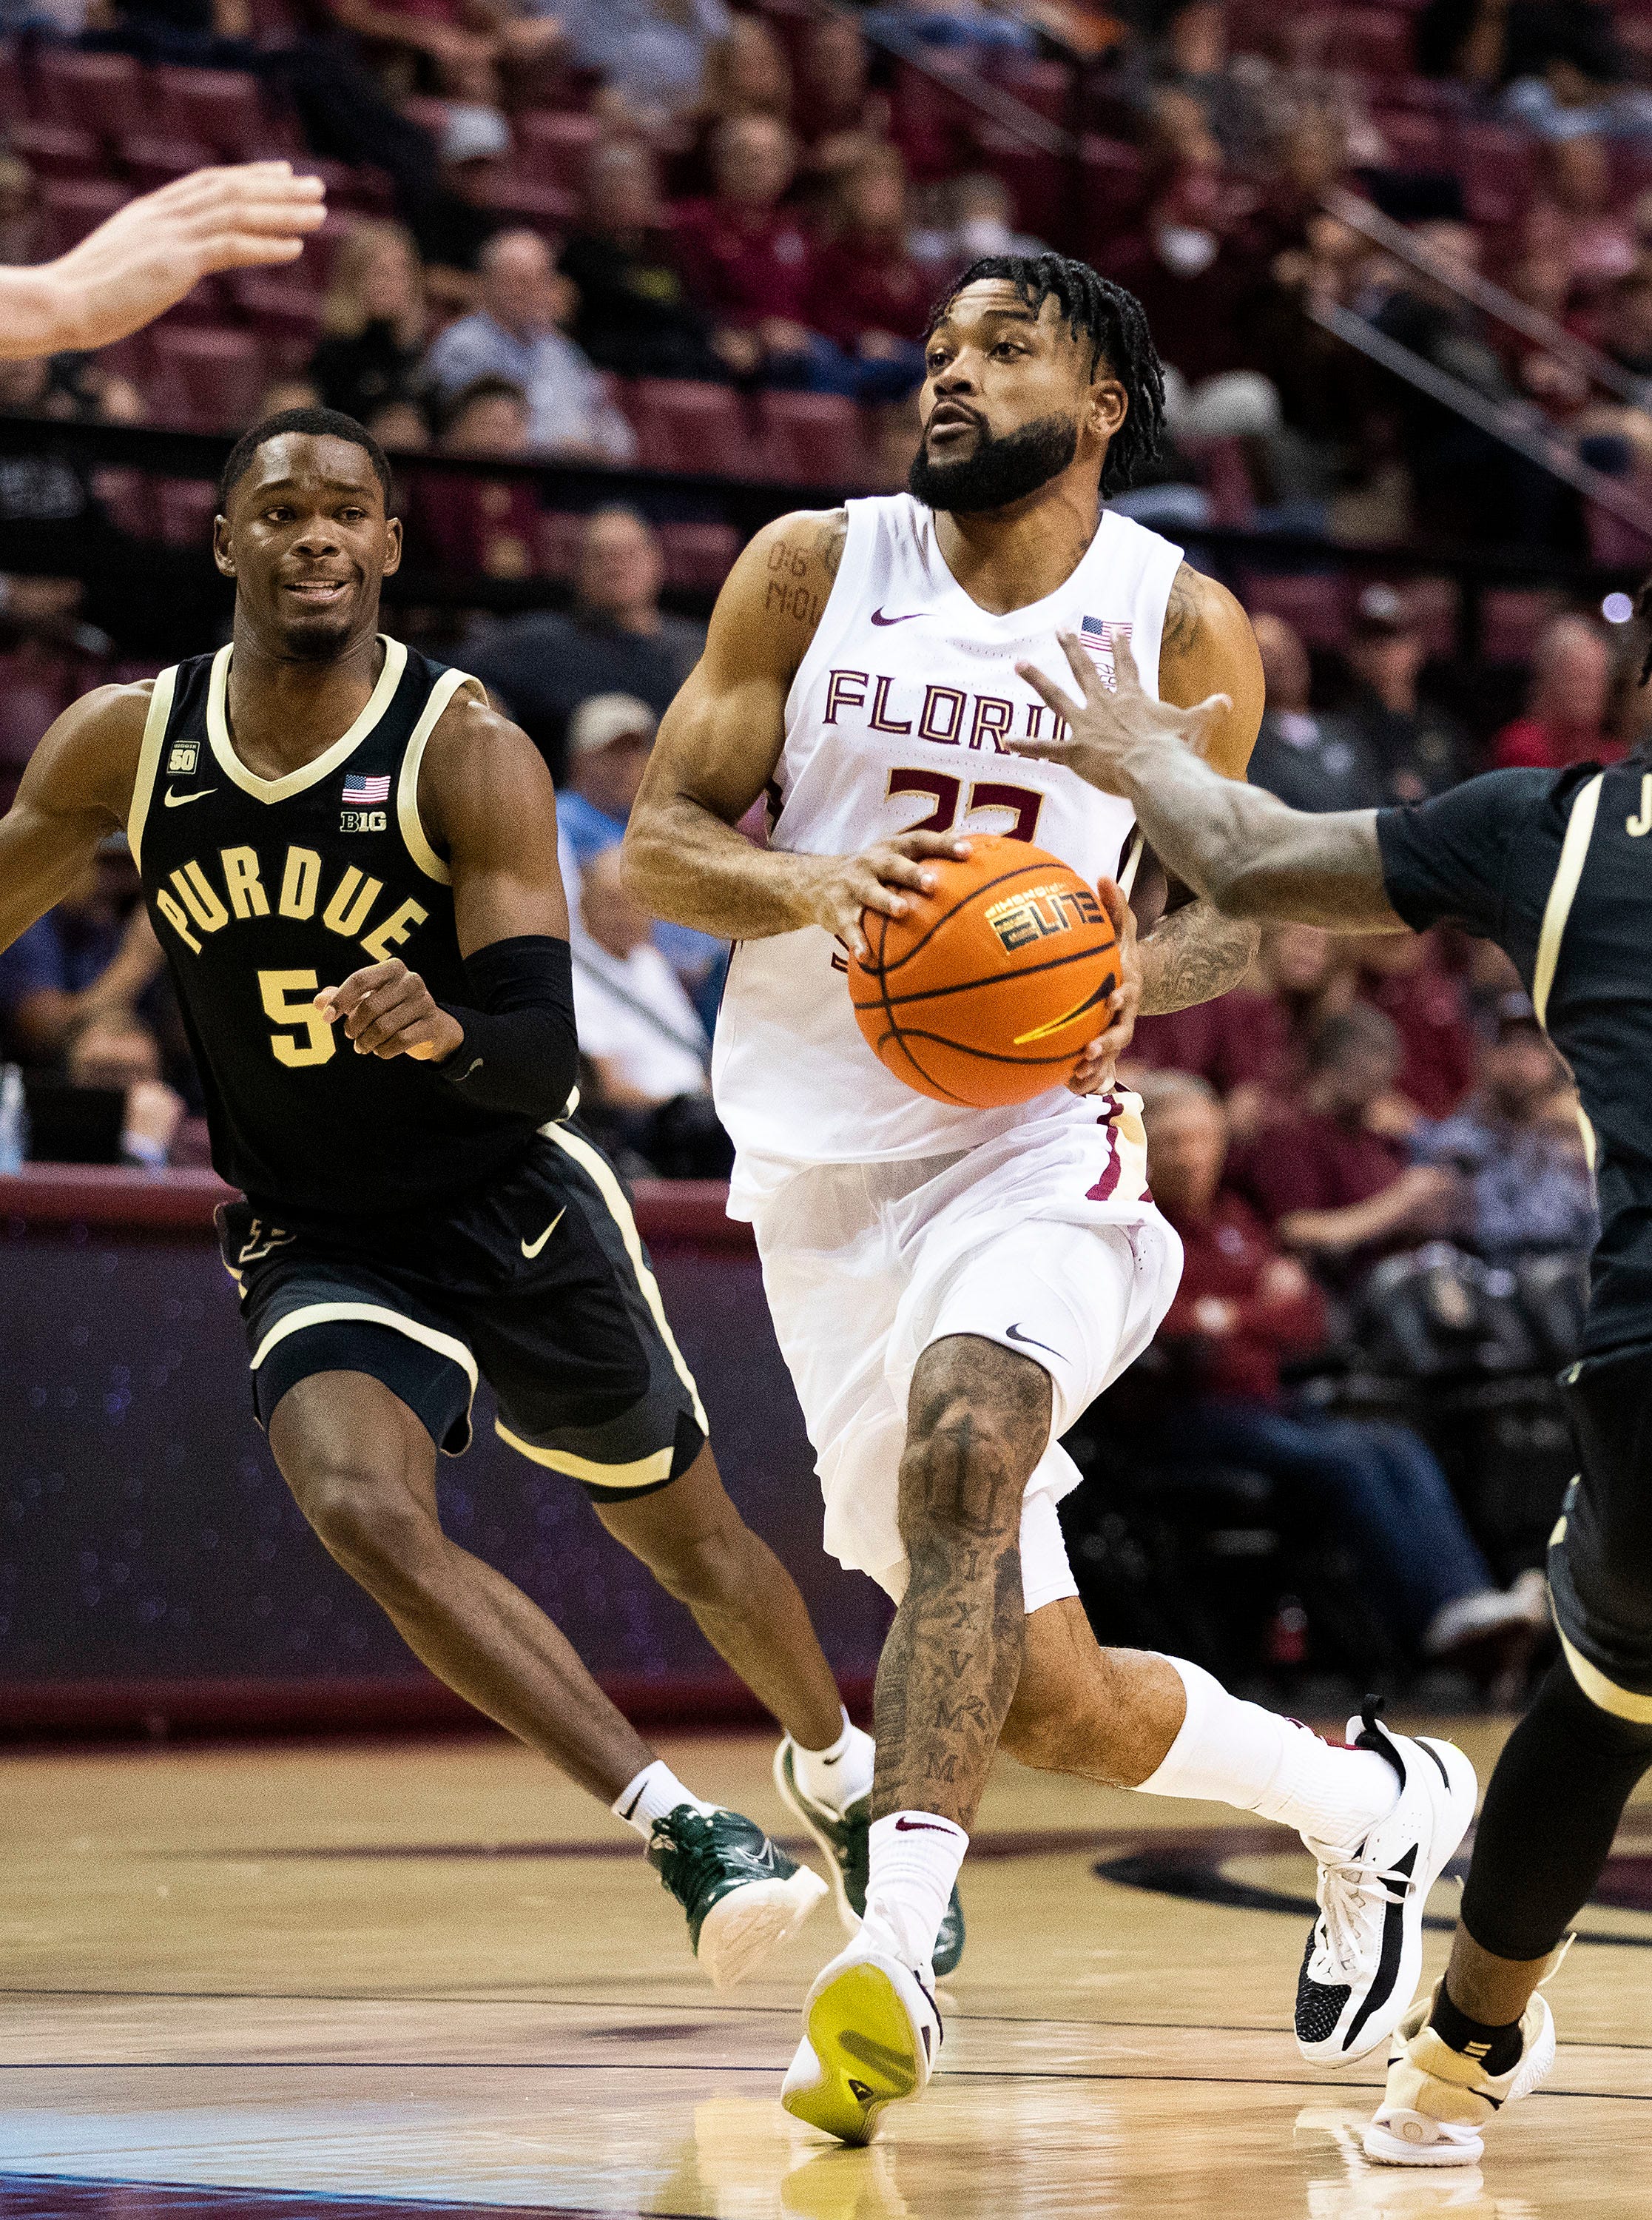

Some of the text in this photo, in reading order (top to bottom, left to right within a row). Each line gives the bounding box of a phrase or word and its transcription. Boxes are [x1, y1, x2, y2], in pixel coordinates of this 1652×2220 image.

[169, 749, 196, 771] 50
[156, 844, 430, 961] PURDUE
[989, 890, 1106, 954] ELITE
[257, 969, 337, 1069] 5
